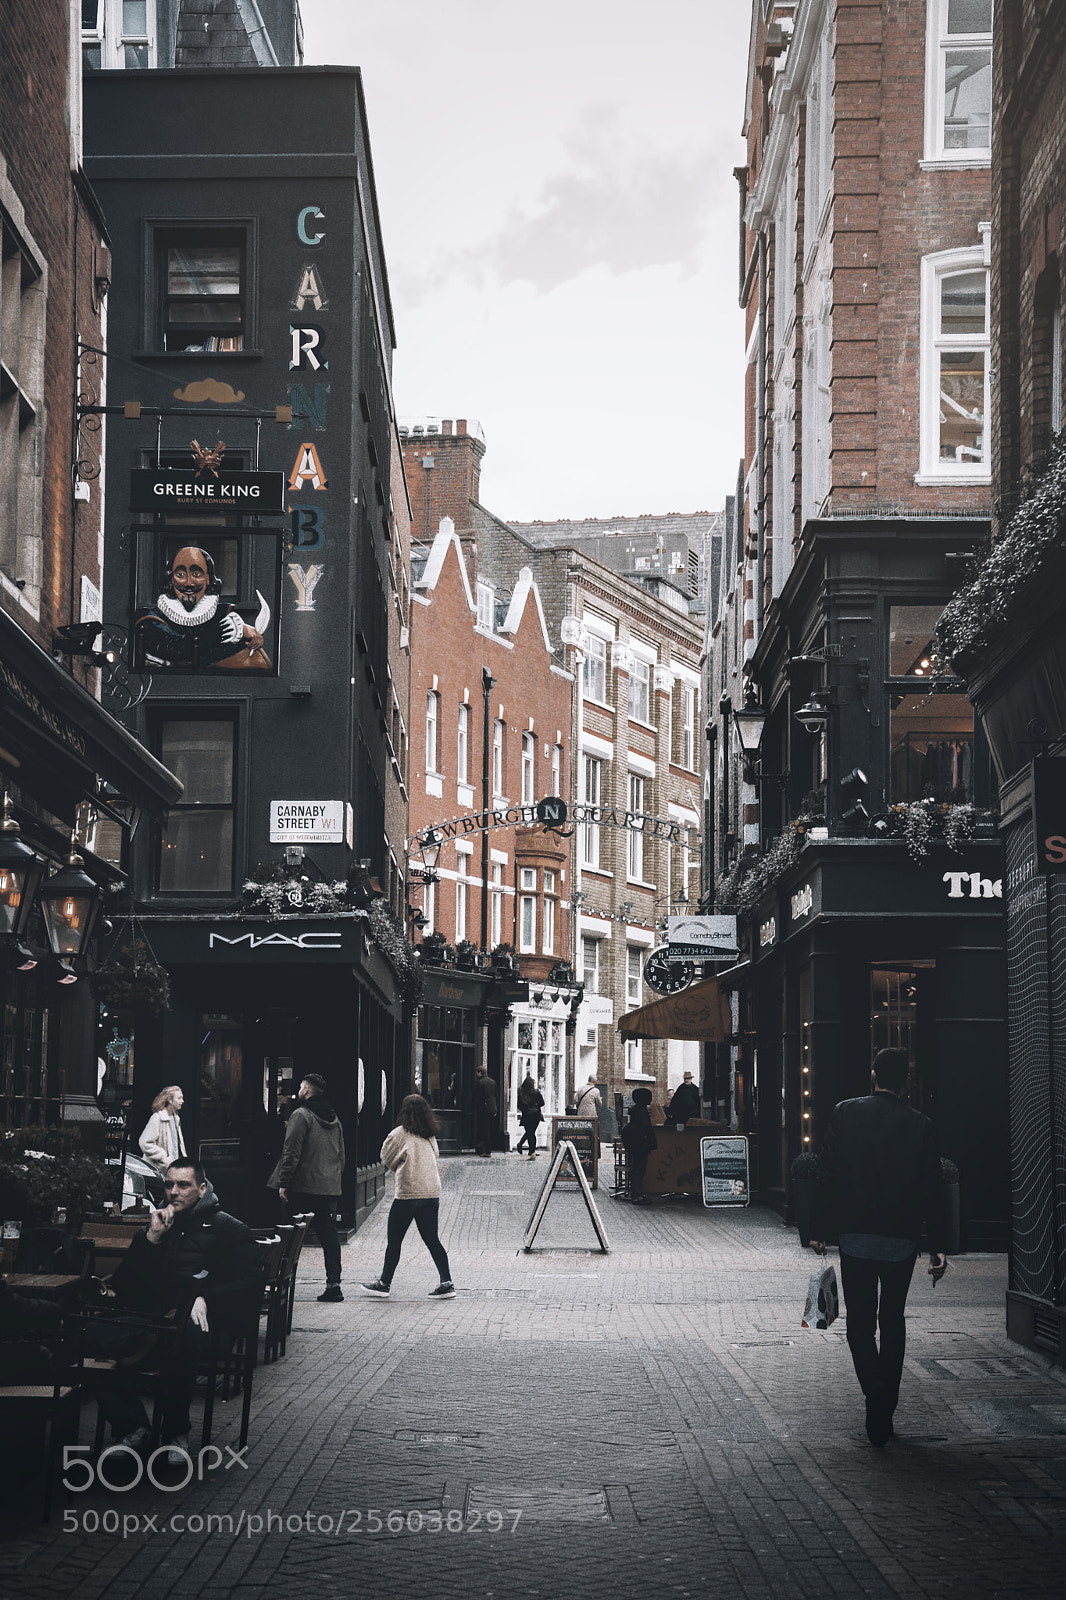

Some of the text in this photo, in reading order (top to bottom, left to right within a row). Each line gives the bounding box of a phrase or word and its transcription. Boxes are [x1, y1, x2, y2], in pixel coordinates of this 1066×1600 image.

[287, 205, 331, 611] CARNABY
[153, 483, 260, 497] GREENE KING
[277, 805, 325, 817] CARNABY
[277, 818, 337, 829] STREET W1
[572, 806, 681, 843] QUARTER
